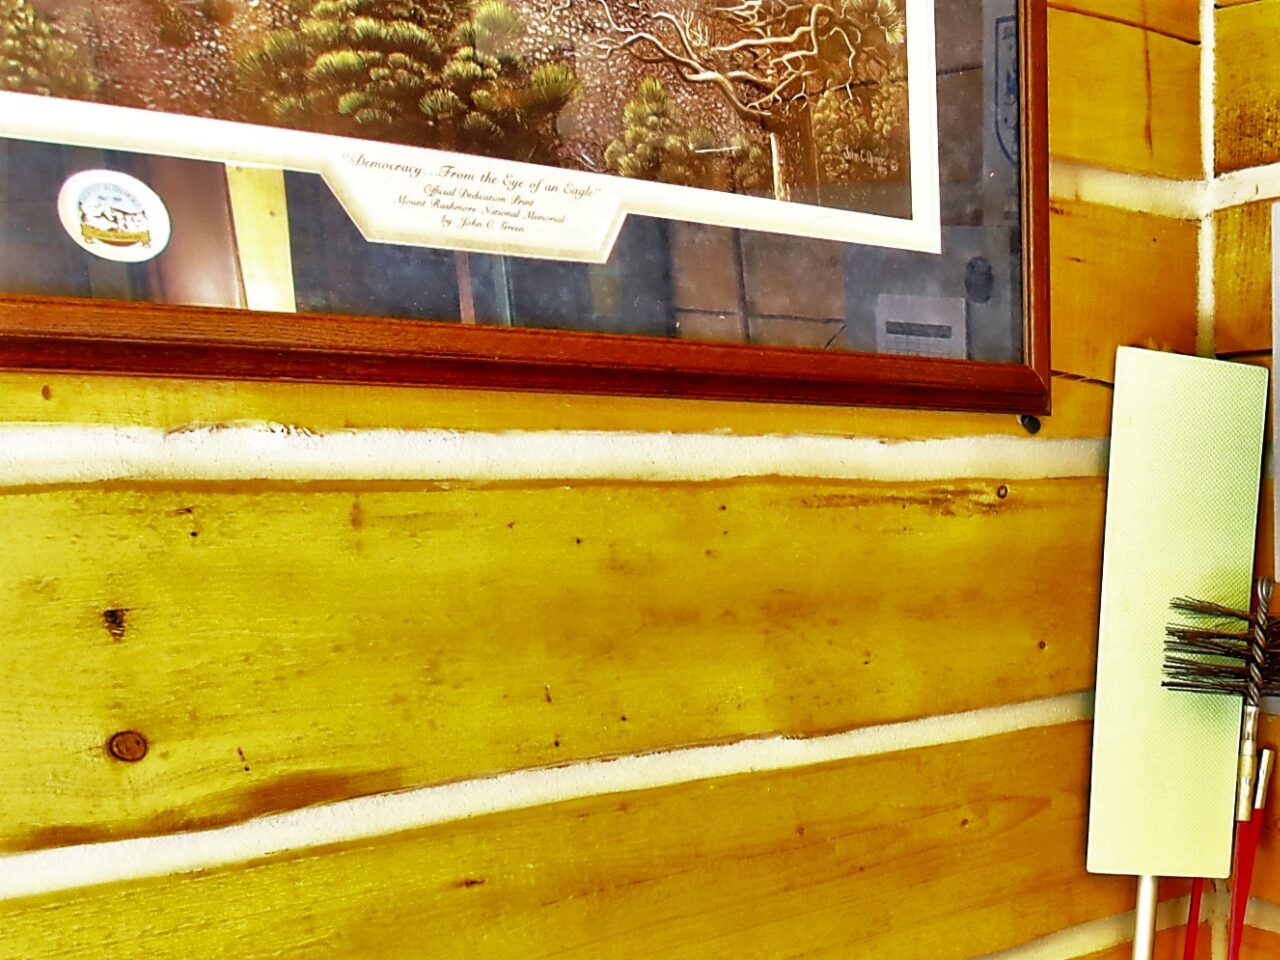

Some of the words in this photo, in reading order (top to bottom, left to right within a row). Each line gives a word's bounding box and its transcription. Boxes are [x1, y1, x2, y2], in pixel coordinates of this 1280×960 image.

[480, 171, 497, 185] the
[502, 173, 524, 191] Eye
[529, 178, 544, 193] of
[545, 184, 559, 192] an
[423, 184, 457, 198] Official
[459, 187, 506, 203] Dedication
[510, 195, 535, 206] Print
[393, 195, 427, 207] Mount
[431, 199, 476, 213] Rushmore
[481, 206, 521, 218] National
[522, 211, 566, 223] Memorial
[441, 215, 453, 227] by
[456, 217, 482, 228] John
[500, 221, 525, 233] Green
